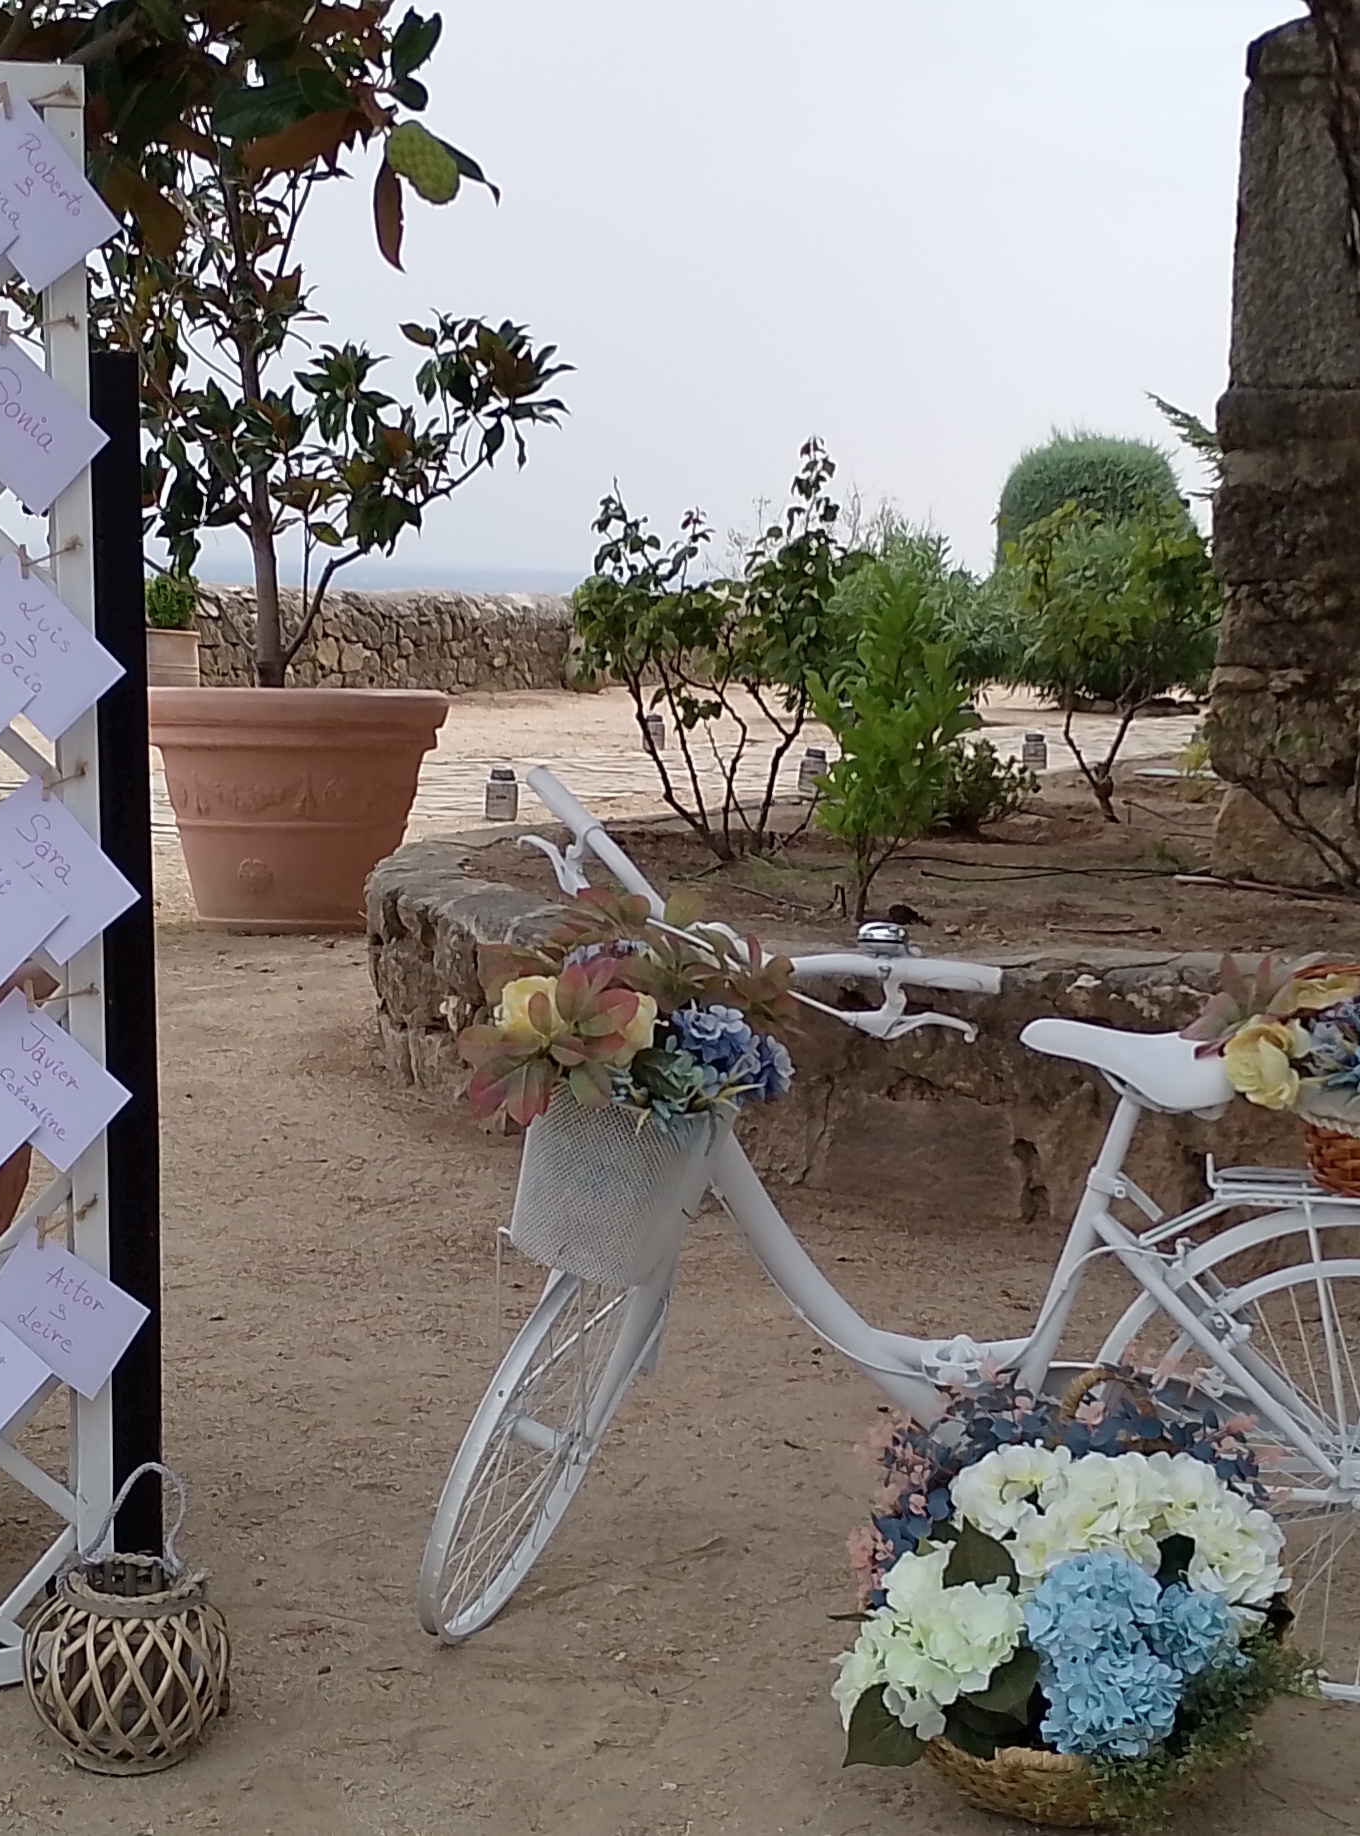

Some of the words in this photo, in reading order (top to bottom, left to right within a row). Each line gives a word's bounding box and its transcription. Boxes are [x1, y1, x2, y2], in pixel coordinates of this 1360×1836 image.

[18, 132, 83, 217] Roberto
[19, 601, 71, 653] Luis
[15, 814, 72, 886] Sara
[21, 1021, 80, 1090] Javier
[46, 1266, 105, 1313] Aitor
[17, 1306, 73, 1355] Leire
